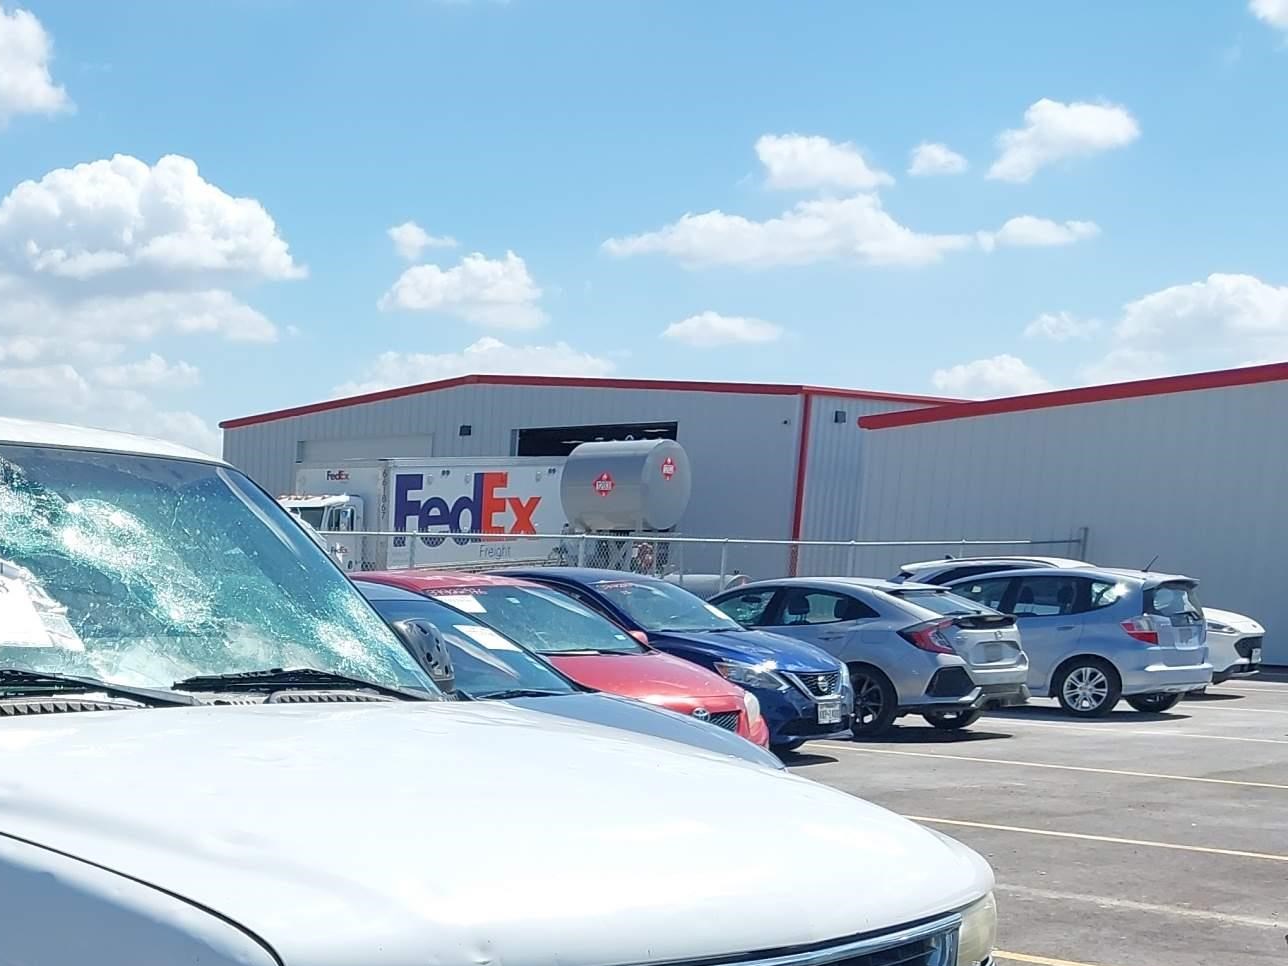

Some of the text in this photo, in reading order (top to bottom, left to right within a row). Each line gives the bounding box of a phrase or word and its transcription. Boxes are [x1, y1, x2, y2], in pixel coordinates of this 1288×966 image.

[326, 470, 350, 481] FedEx
[393, 471, 542, 547] FedEx
[478, 544, 511, 561] Freight
